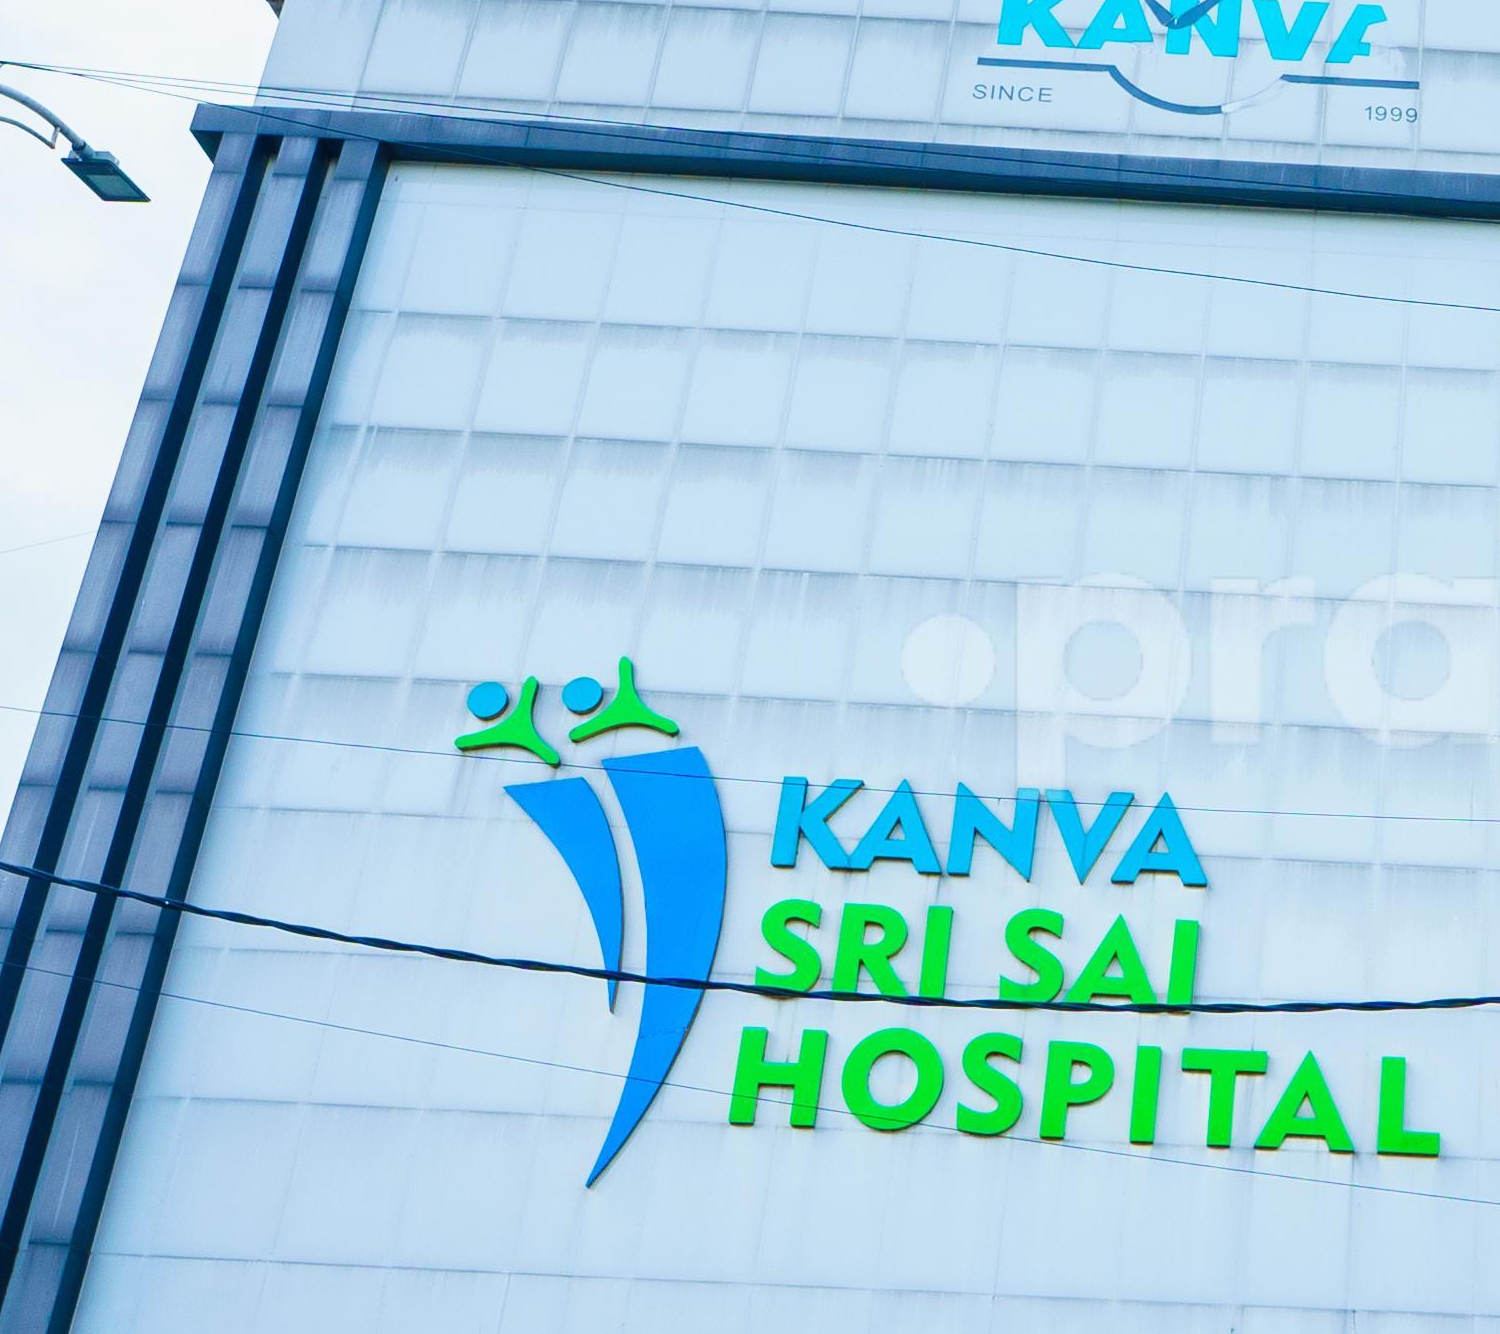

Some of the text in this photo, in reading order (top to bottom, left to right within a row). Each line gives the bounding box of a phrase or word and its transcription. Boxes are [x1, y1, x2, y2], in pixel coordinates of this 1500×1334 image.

[972, 83, 1419, 124] SINCE 1999
[770, 774, 1209, 888] KANVA
[754, 898, 1200, 1015] SRI SAI
[728, 1025, 1441, 1158] HOSPITAL
